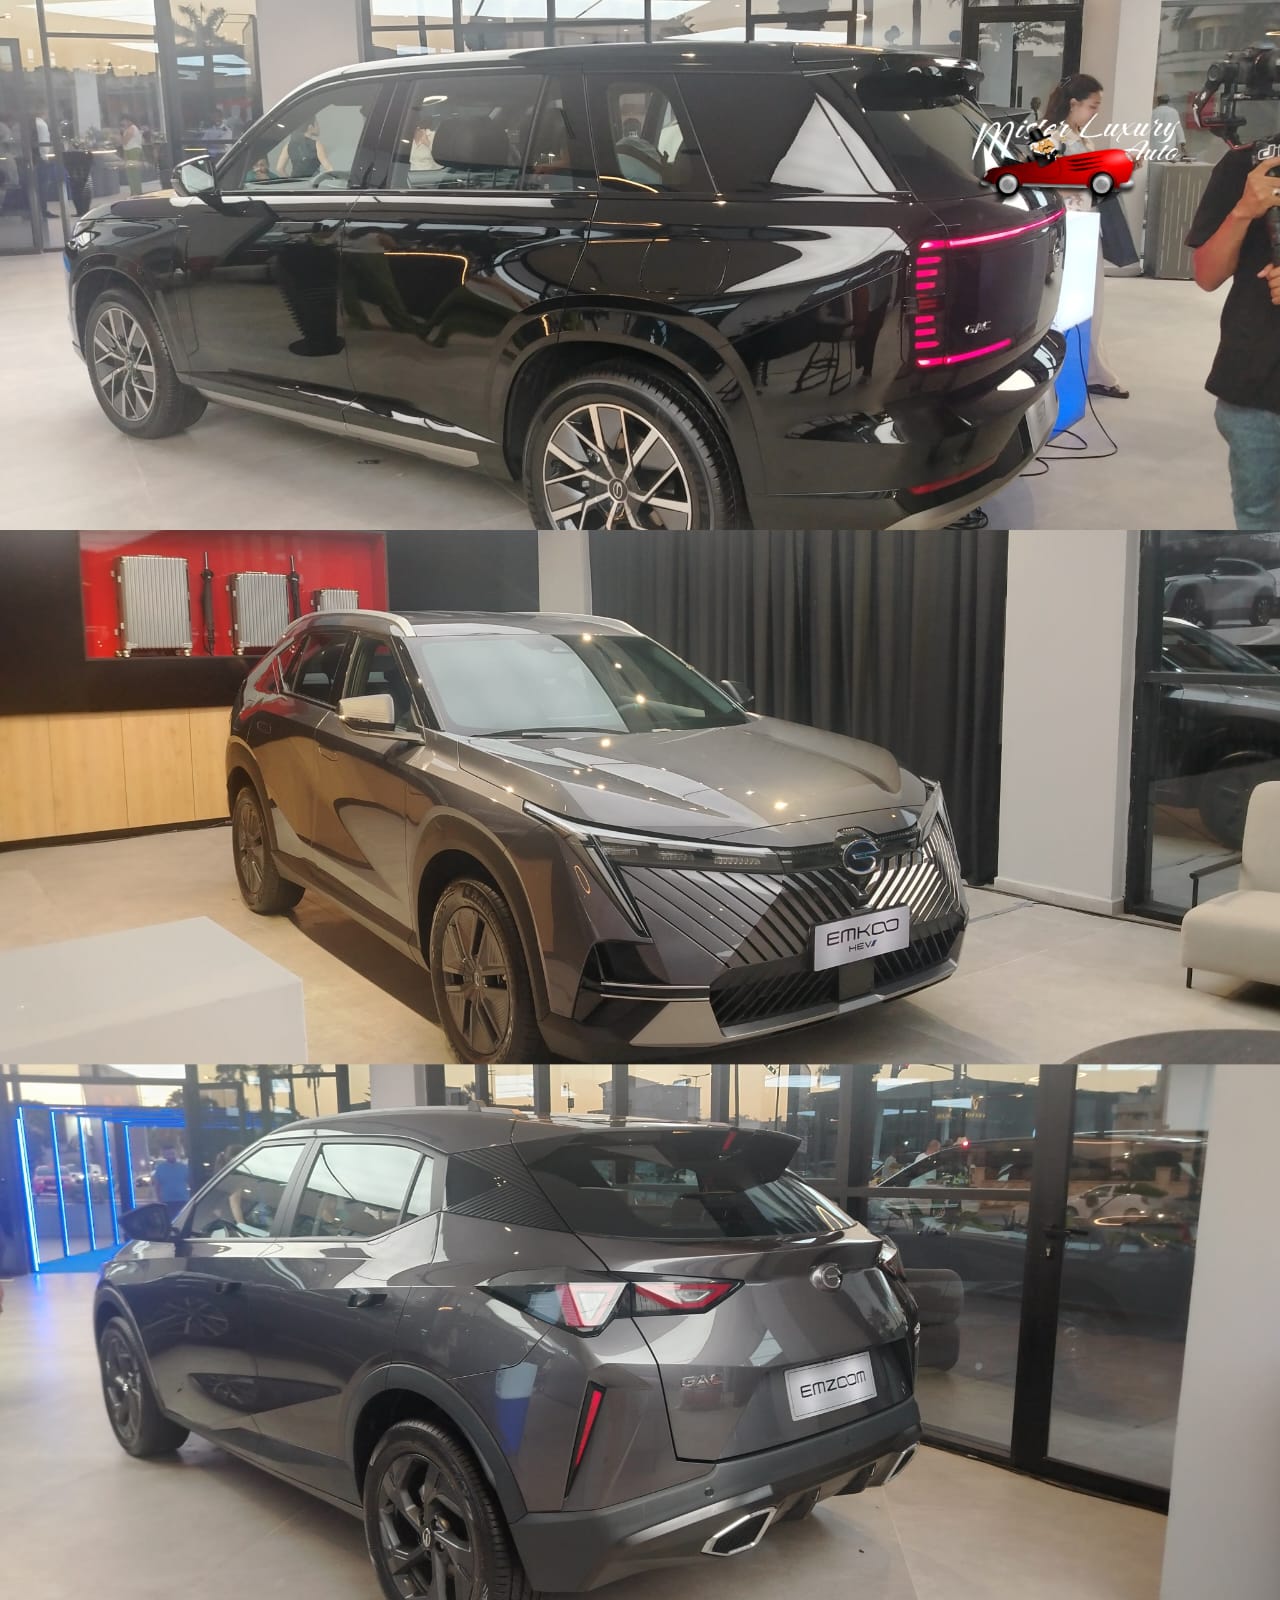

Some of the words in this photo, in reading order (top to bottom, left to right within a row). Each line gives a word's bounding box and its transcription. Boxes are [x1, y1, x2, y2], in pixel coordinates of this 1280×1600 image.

[964, 320, 992, 334] GAC
[827, 918, 899, 946] EMKOO
[681, 1374, 723, 1388] GAC
[800, 1370, 867, 1398] EMZOOM
